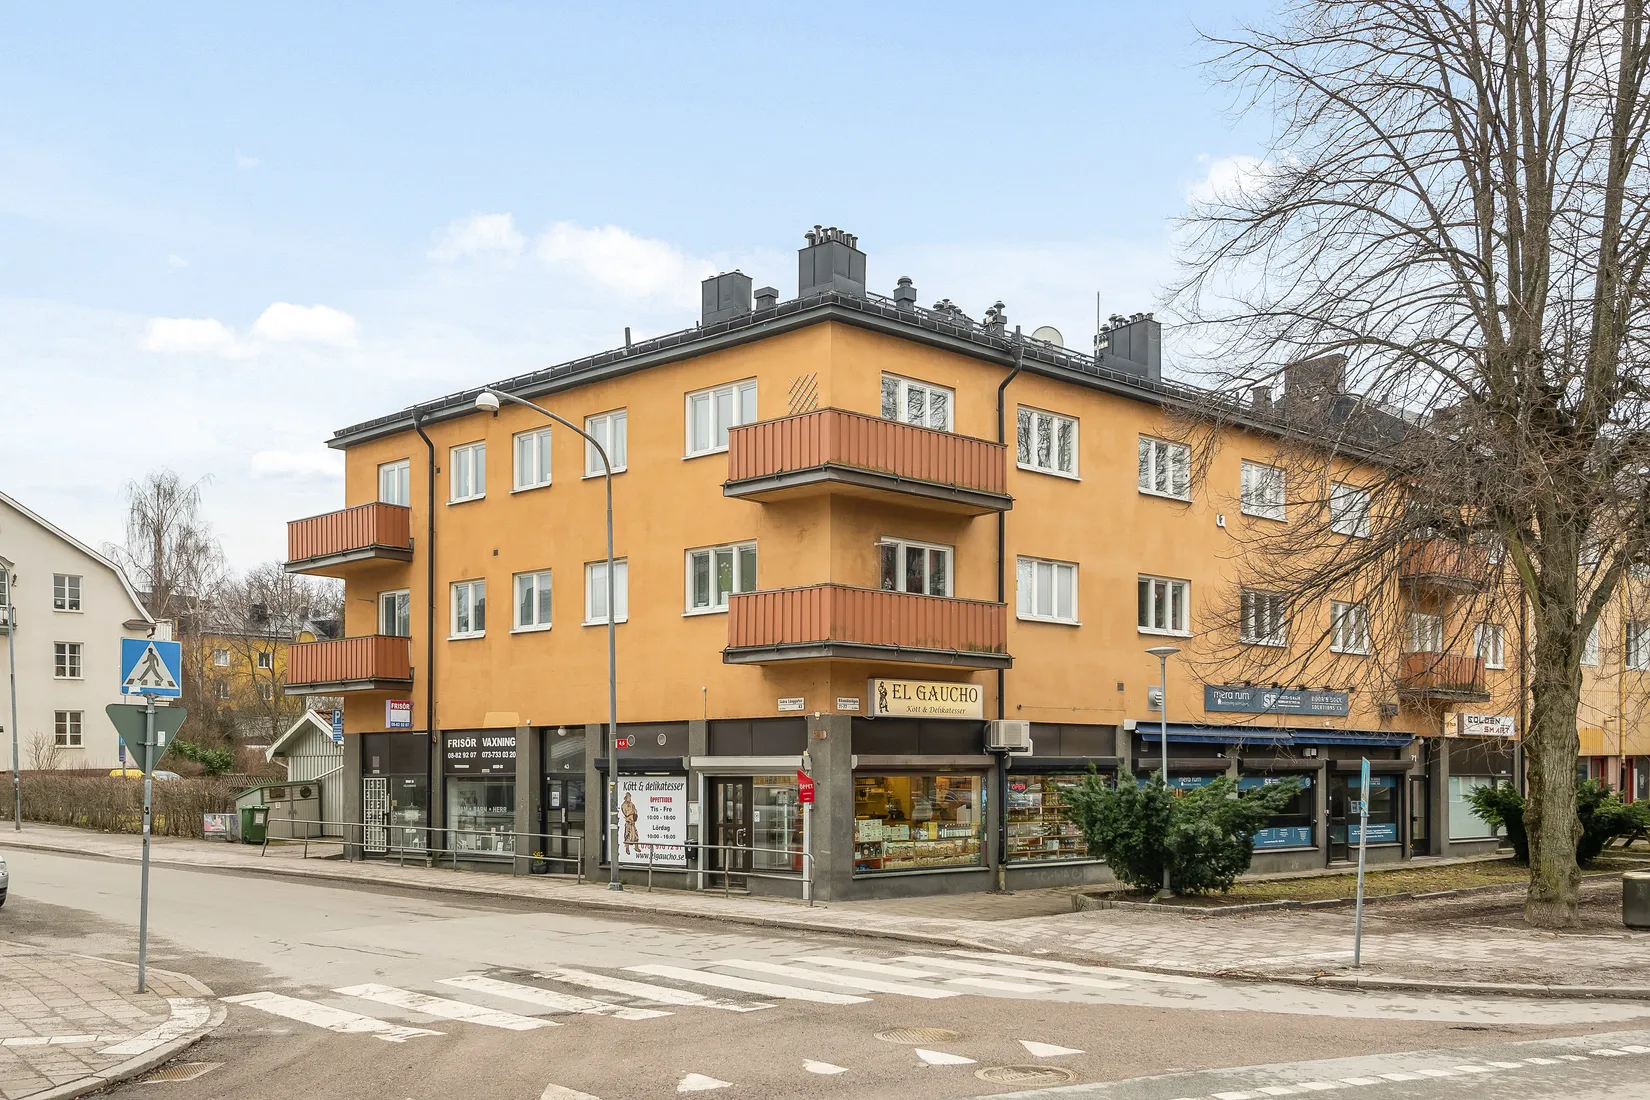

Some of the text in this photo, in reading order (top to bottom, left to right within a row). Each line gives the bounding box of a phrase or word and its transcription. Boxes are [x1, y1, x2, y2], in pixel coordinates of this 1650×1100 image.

[893, 684, 978, 703] EL GAUCHO
[1235, 692, 1250, 700] rum
[906, 705, 921, 713] Kött
[929, 706, 966, 714] Delikatesser
[334, 711, 341, 724] P
[1467, 715, 1501, 724] GOLDEN
[1484, 726, 1510, 734] SMART
[448, 737, 516, 748] FRISÖR VAXNING
[623, 781, 685, 791] Kött & delikatesser
